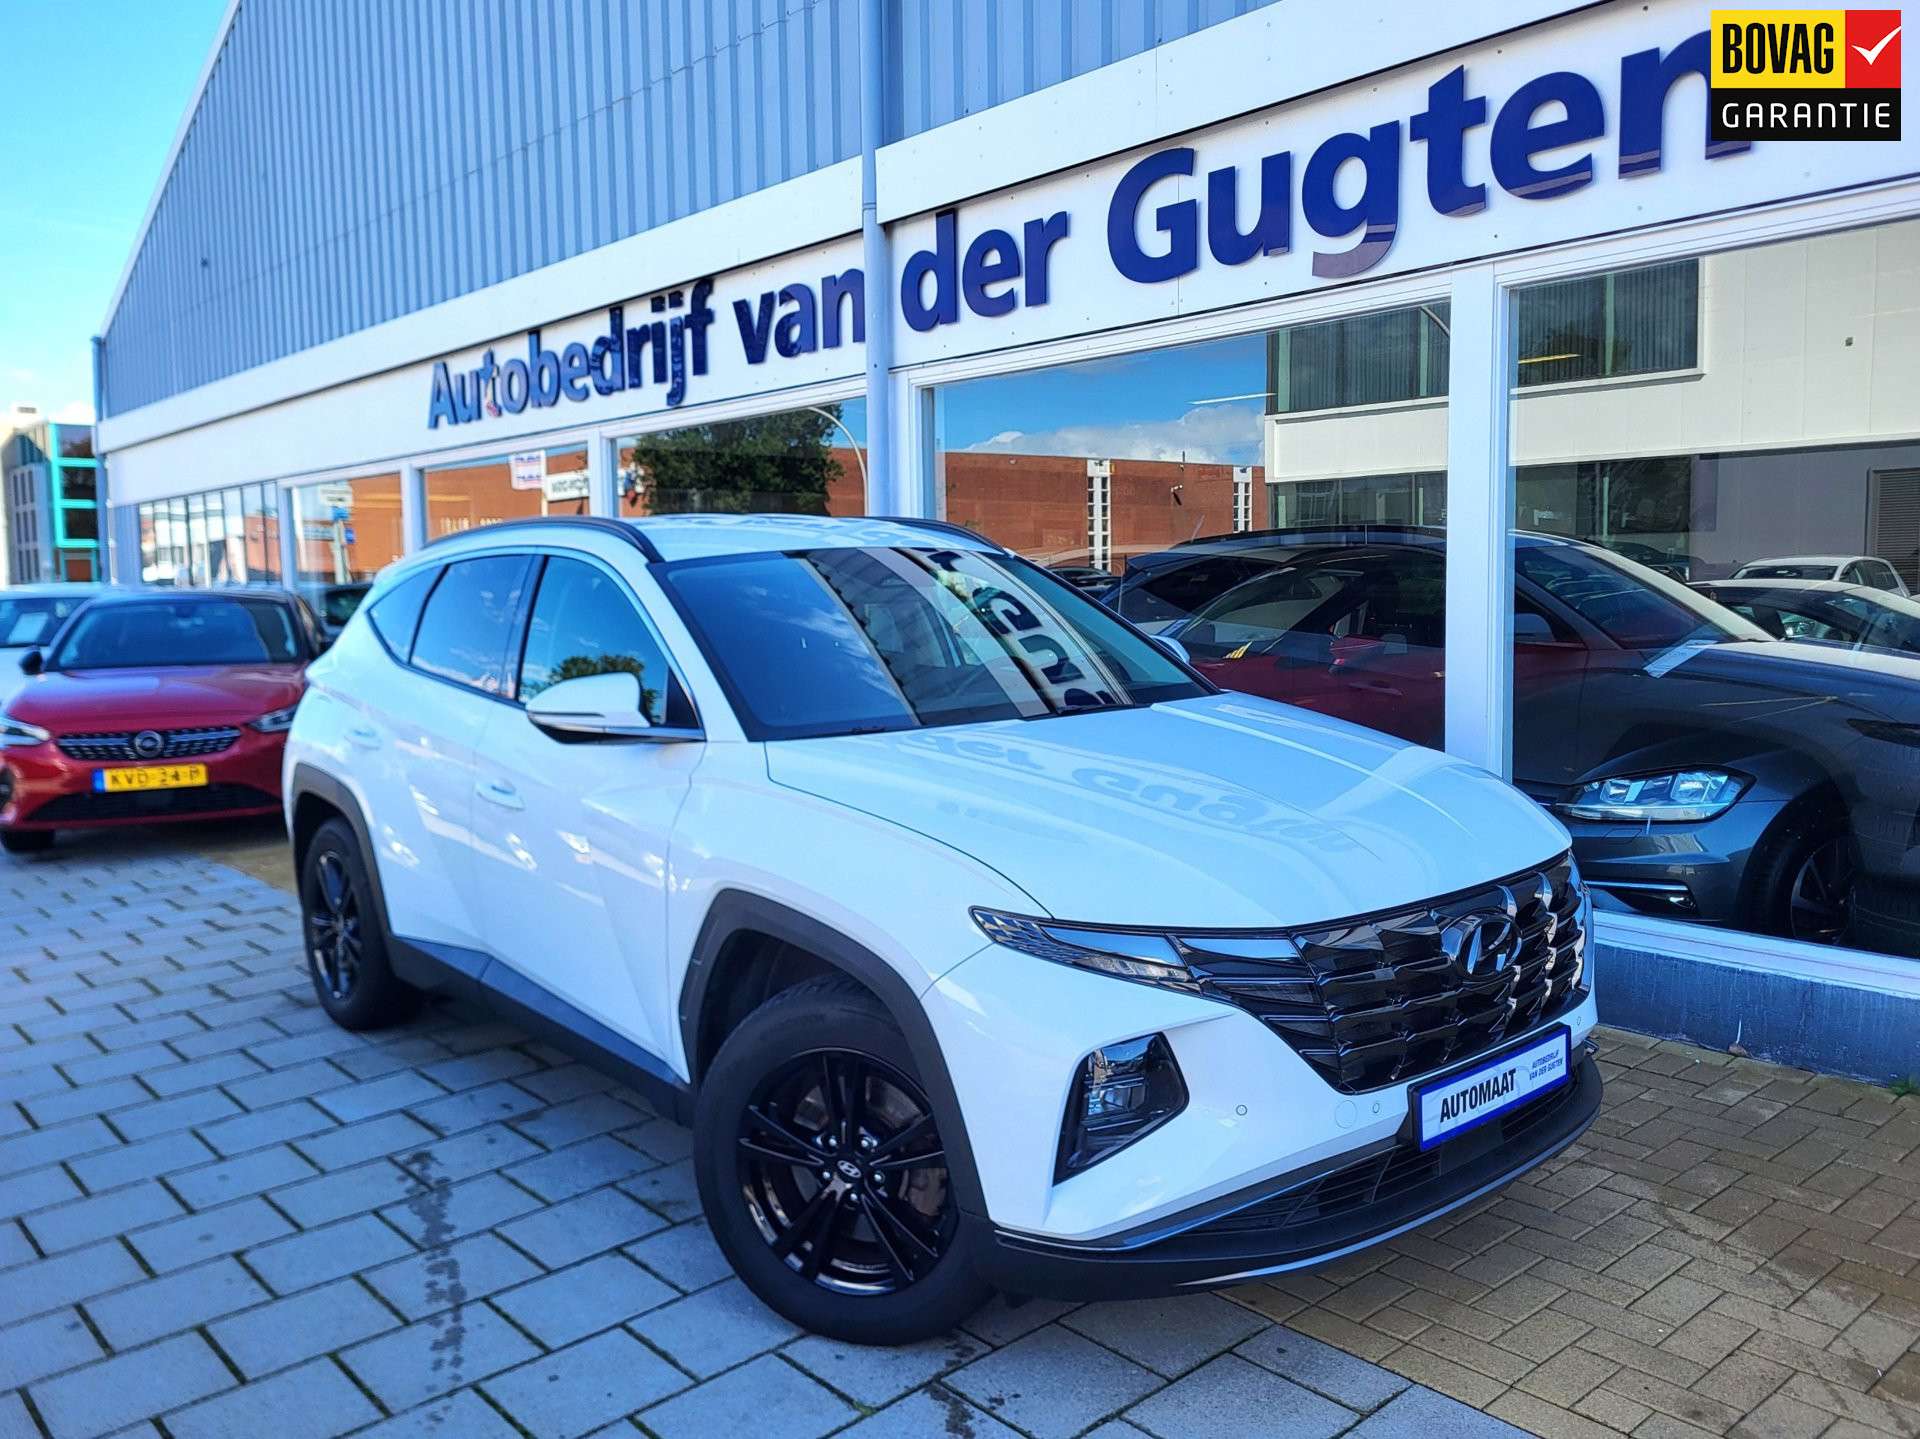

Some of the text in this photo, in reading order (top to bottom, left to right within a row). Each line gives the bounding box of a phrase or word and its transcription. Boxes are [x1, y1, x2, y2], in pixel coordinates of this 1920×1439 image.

[427, 30, 1752, 407] Autobedrijf van der Gugten
[1440, 1068, 1517, 1123] AUTOMAAT
